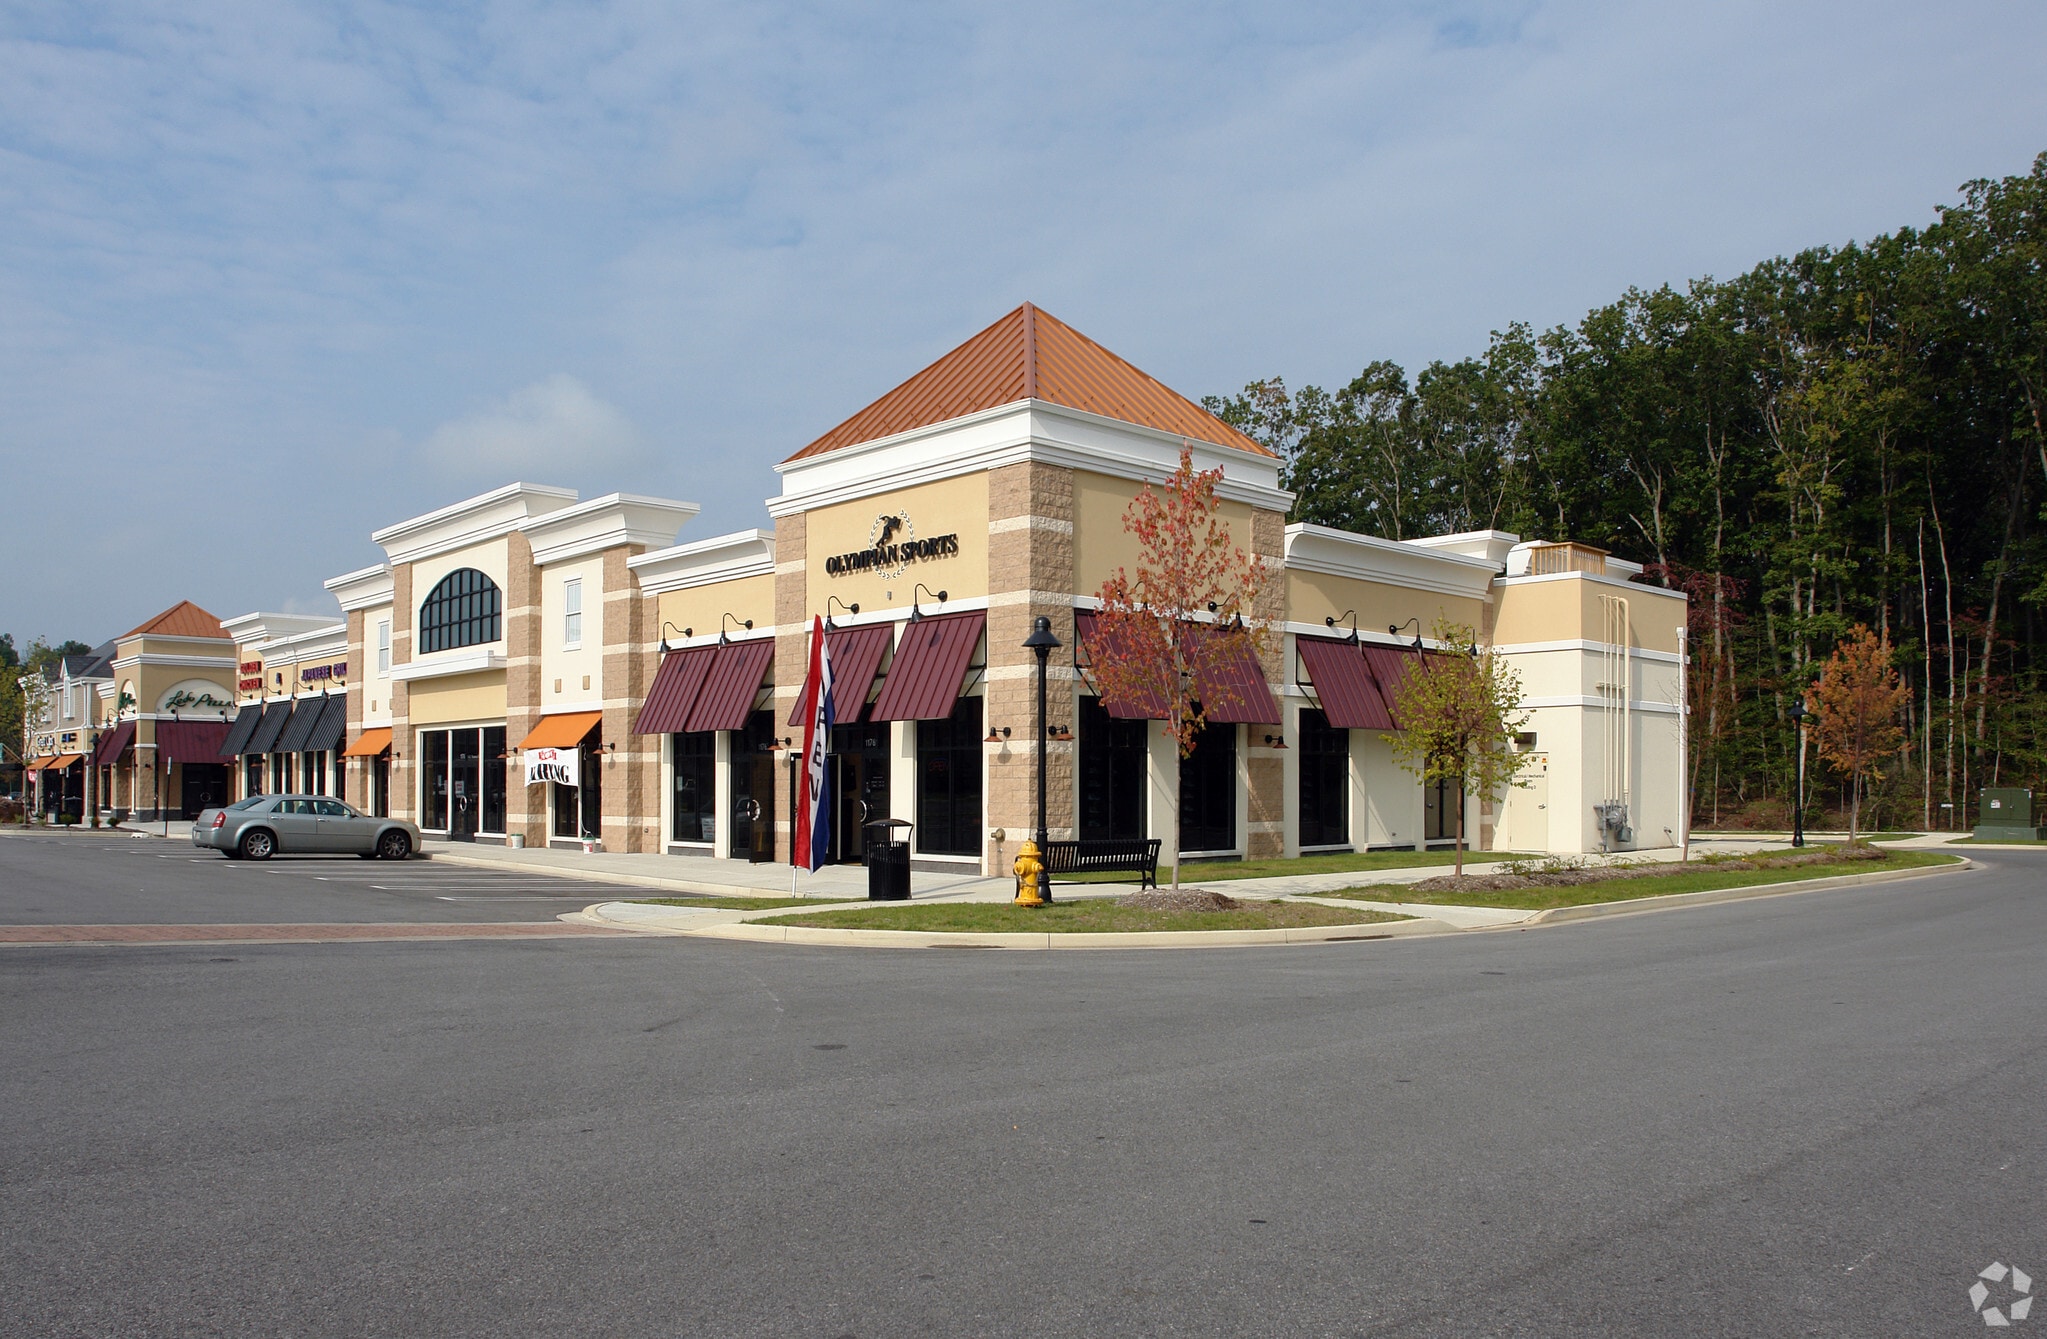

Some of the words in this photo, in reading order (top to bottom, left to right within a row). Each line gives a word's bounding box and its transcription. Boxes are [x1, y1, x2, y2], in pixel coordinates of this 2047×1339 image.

[825, 544, 898, 575] OLYMPIAN
[900, 533, 958, 562] SPORTS
[333, 662, 347, 677] GRIL
